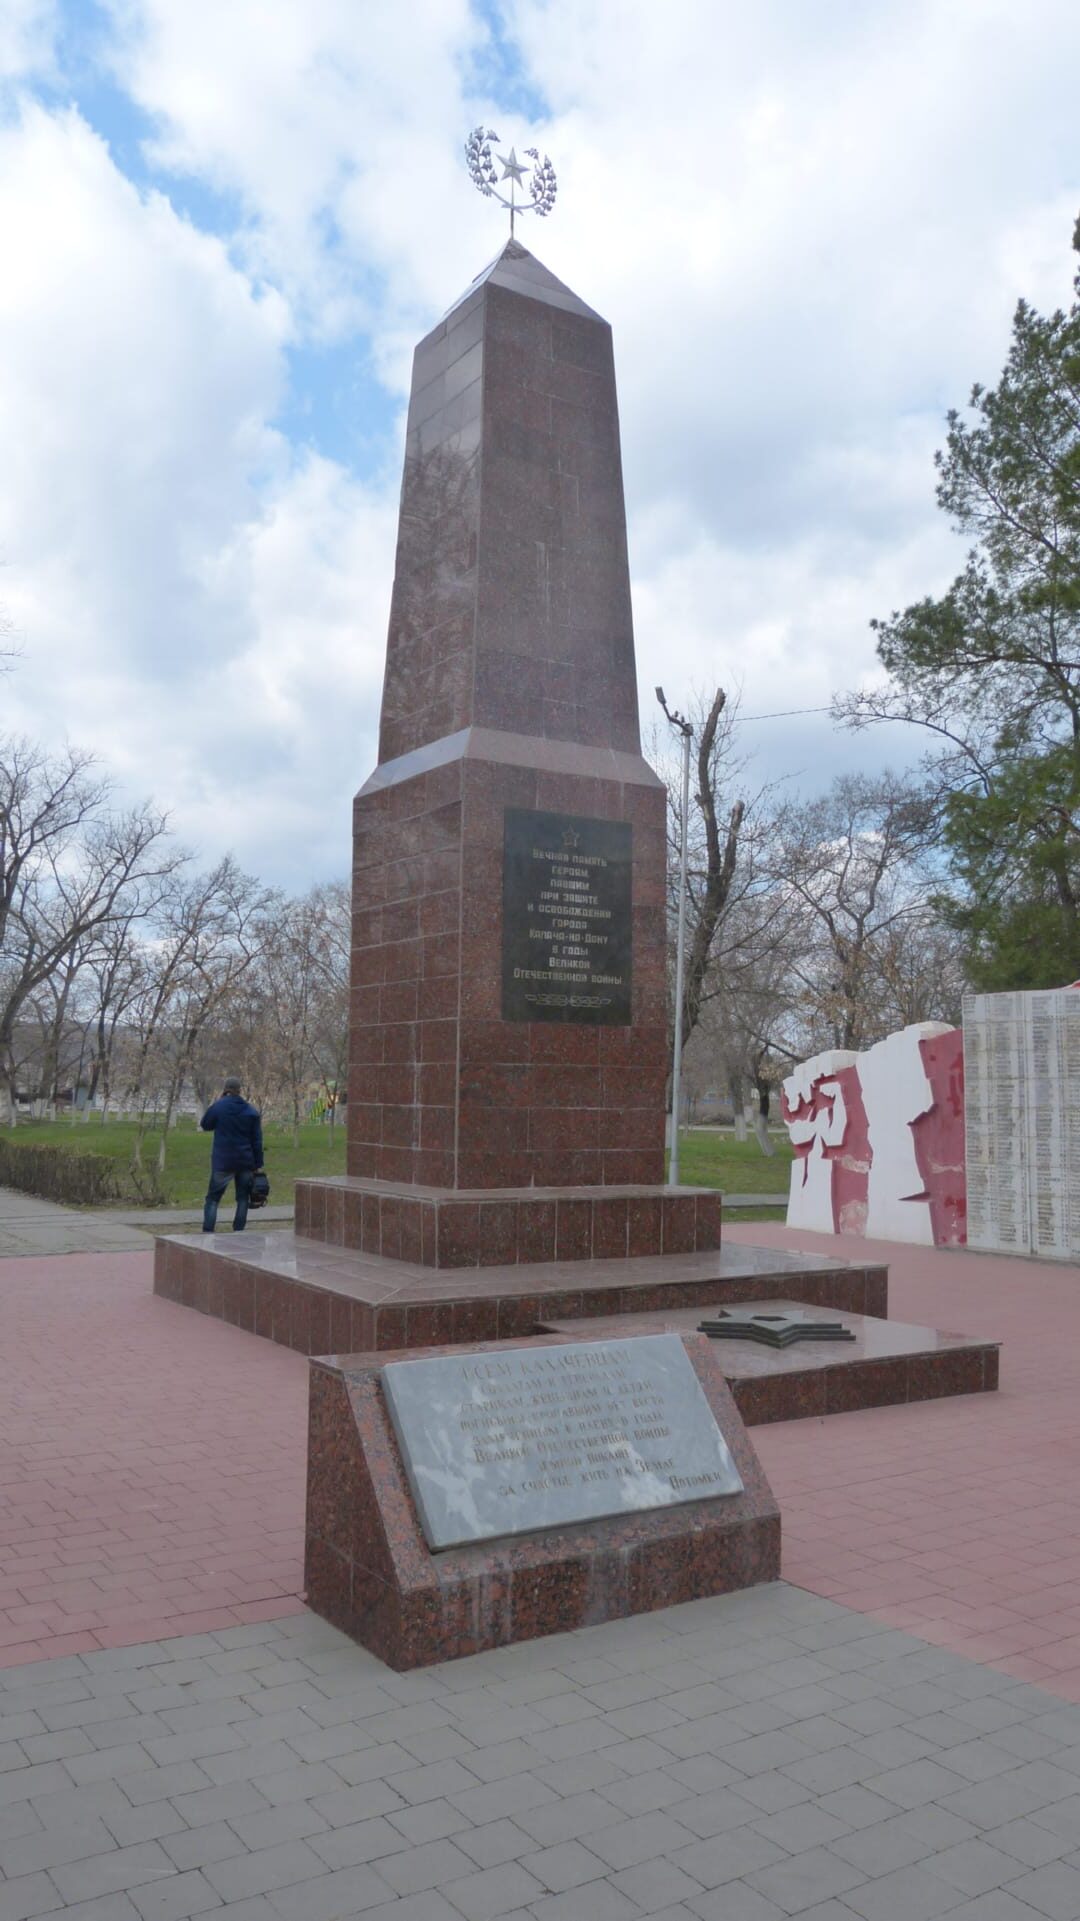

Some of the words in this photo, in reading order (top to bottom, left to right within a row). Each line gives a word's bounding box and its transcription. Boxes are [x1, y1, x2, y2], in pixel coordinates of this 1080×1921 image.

[540, 891, 559, 901] ПРИ
[527, 903, 534, 912] И
[552, 918, 587, 929] ГОРОДА
[562, 946, 588, 956] ГОДЫ
